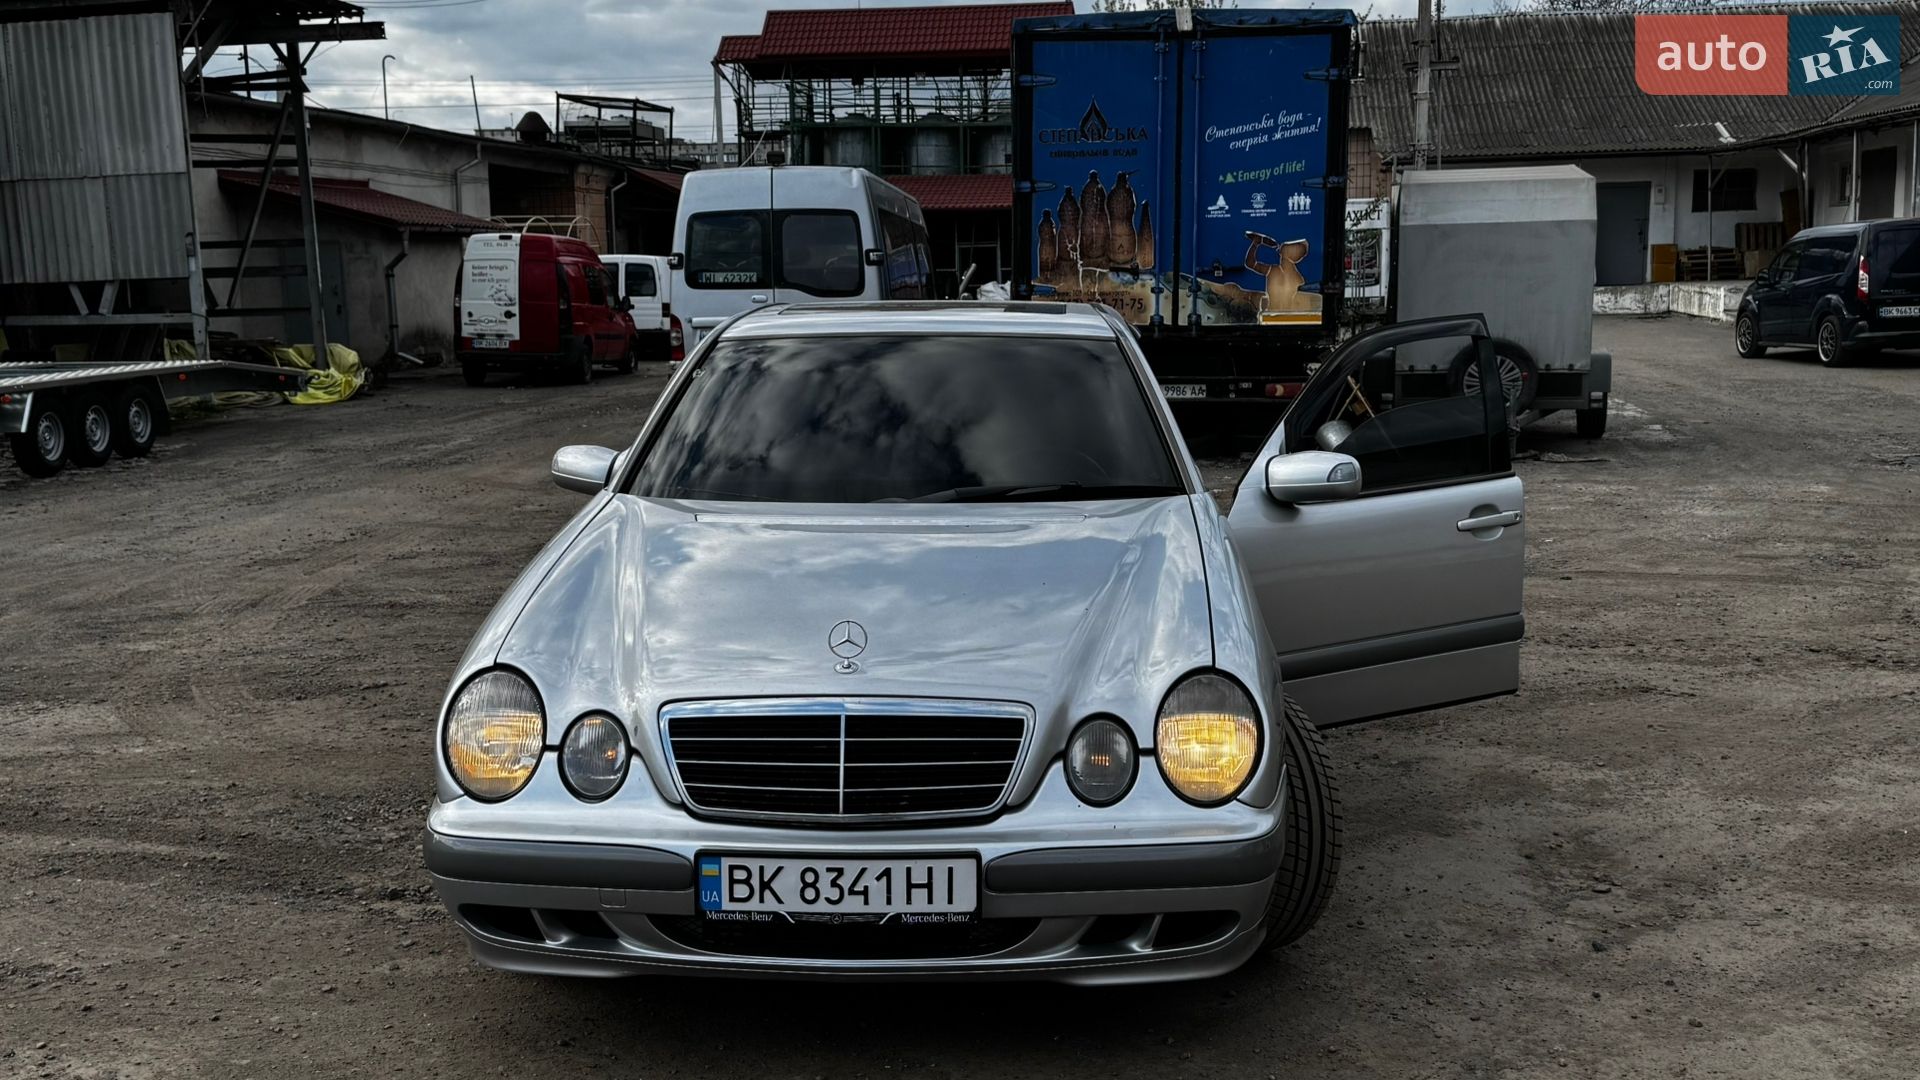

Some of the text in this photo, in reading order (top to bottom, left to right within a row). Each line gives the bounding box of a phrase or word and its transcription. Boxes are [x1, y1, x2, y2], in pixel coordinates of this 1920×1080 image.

[1205, 113, 1275, 143] Степанська
[1277, 109, 1303, 128] вода
[1229, 117, 1321, 152] енергія життя!
[1238, 160, 1305, 182] Energy of life!
[1164, 385, 1187, 396] 9986
[727, 864, 954, 906] BK 8341 HI
[702, 890, 720, 903] UA
[706, 911, 774, 921] Mercedes-Benz
[901, 912, 970, 923] Mercedes-Benz
